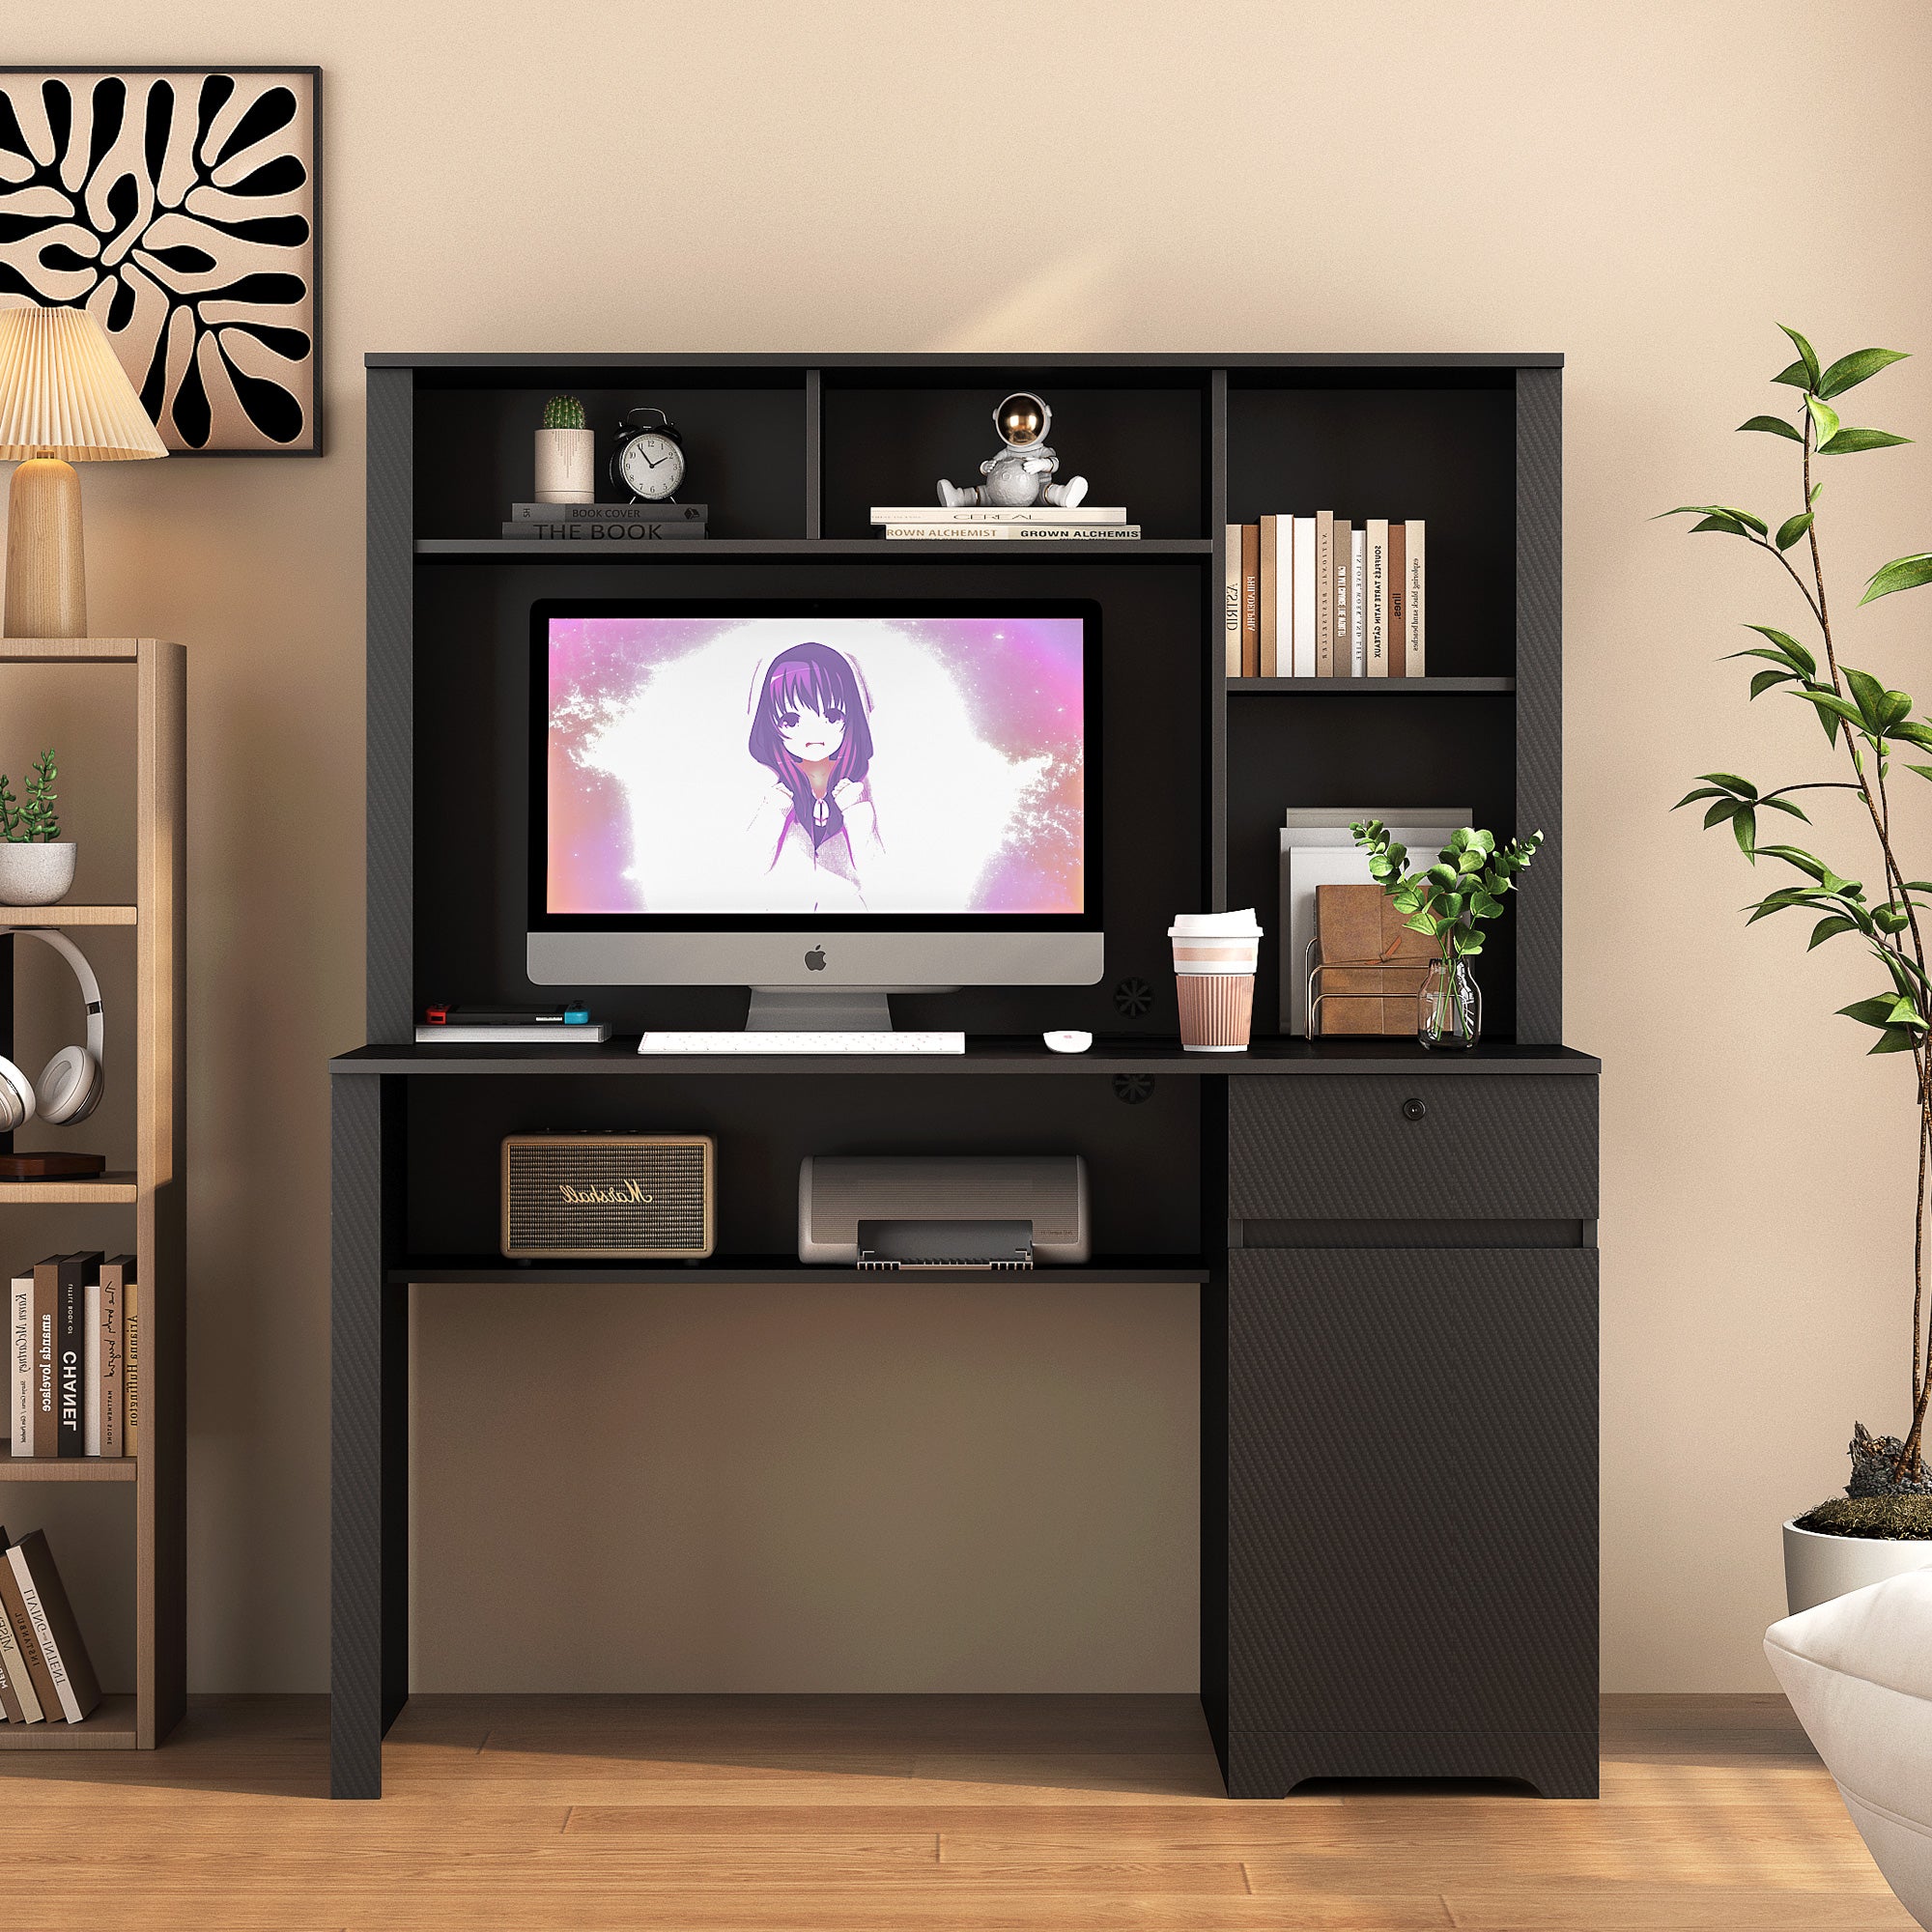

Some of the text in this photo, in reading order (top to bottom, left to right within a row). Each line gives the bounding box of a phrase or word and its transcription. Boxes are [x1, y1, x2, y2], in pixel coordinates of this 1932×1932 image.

[572, 509, 640, 518] BOOK COVER
[533, 524, 663, 540] THE BOOK
[929, 528, 997, 537] ALCHEMIST
[1020, 529, 1069, 538] GROWN
